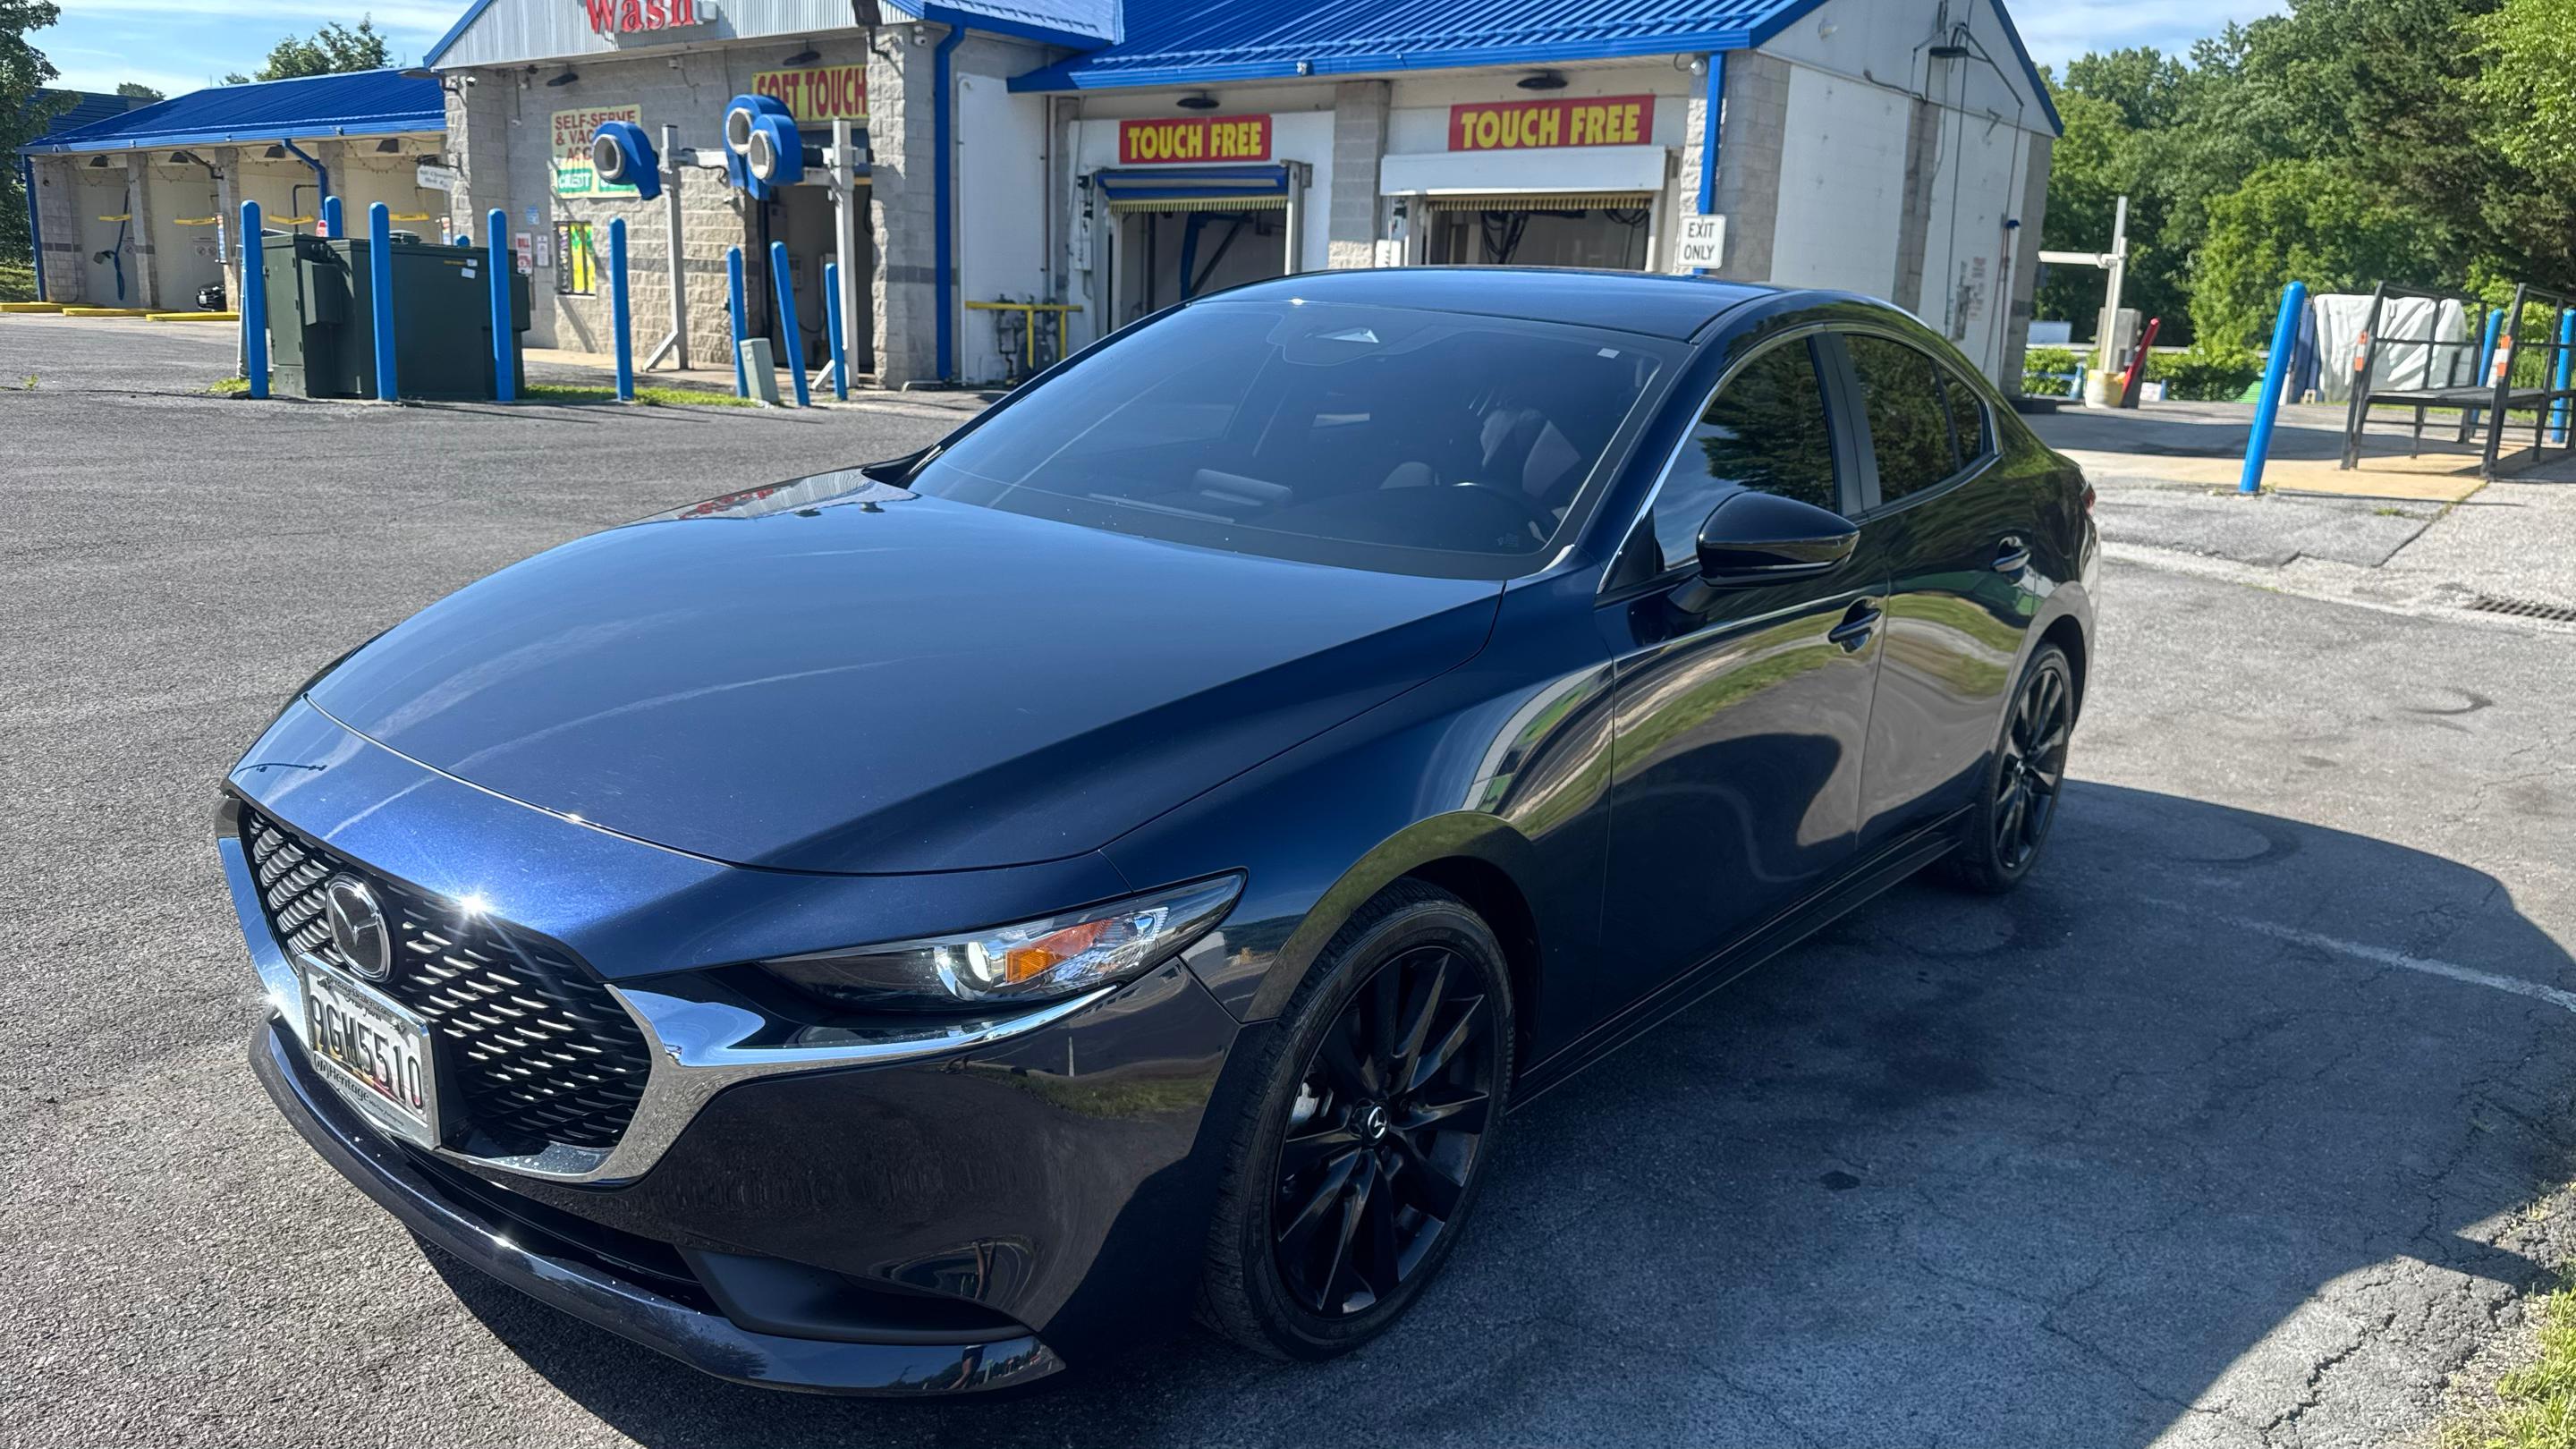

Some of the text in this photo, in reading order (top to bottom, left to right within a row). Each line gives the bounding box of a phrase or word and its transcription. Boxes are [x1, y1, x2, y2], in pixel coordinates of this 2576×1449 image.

[587, 0, 695, 34] Wash
[806, 68, 867, 117] TOUCH
[555, 110, 636, 131] SELF-SERVE
[1460, 104, 1640, 149] TOUCH FREE
[555, 131, 565, 146] &
[1128, 122, 1262, 159] TOUCH FREE
[1688, 222, 1715, 238] EXIT
[1683, 243, 1716, 260] ONLY
[309, 996, 424, 1110] 9GM5510
[329, 1064, 369, 1102] Heritage
